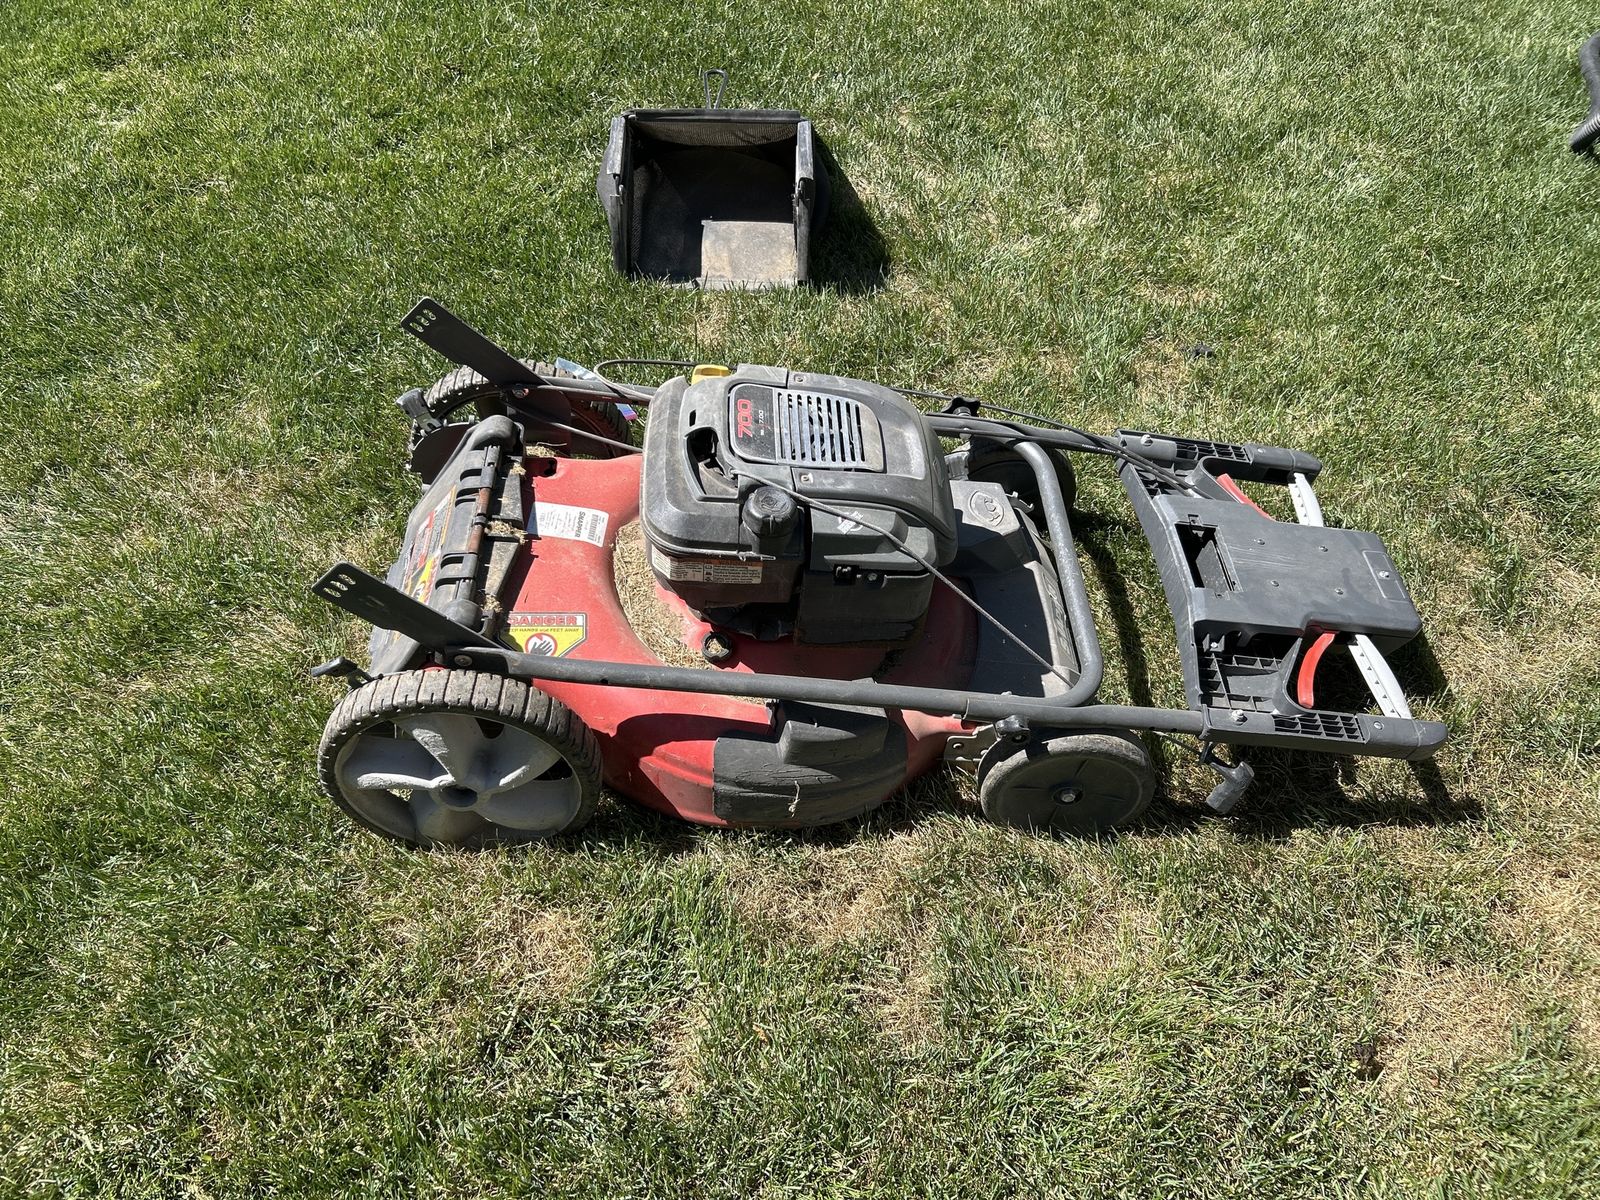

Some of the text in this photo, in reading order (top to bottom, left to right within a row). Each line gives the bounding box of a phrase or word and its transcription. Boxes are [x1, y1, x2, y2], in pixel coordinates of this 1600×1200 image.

[737, 399, 753, 438] 700
[574, 511, 586, 538] SNAPPER
[509, 615, 577, 626] DANGER
